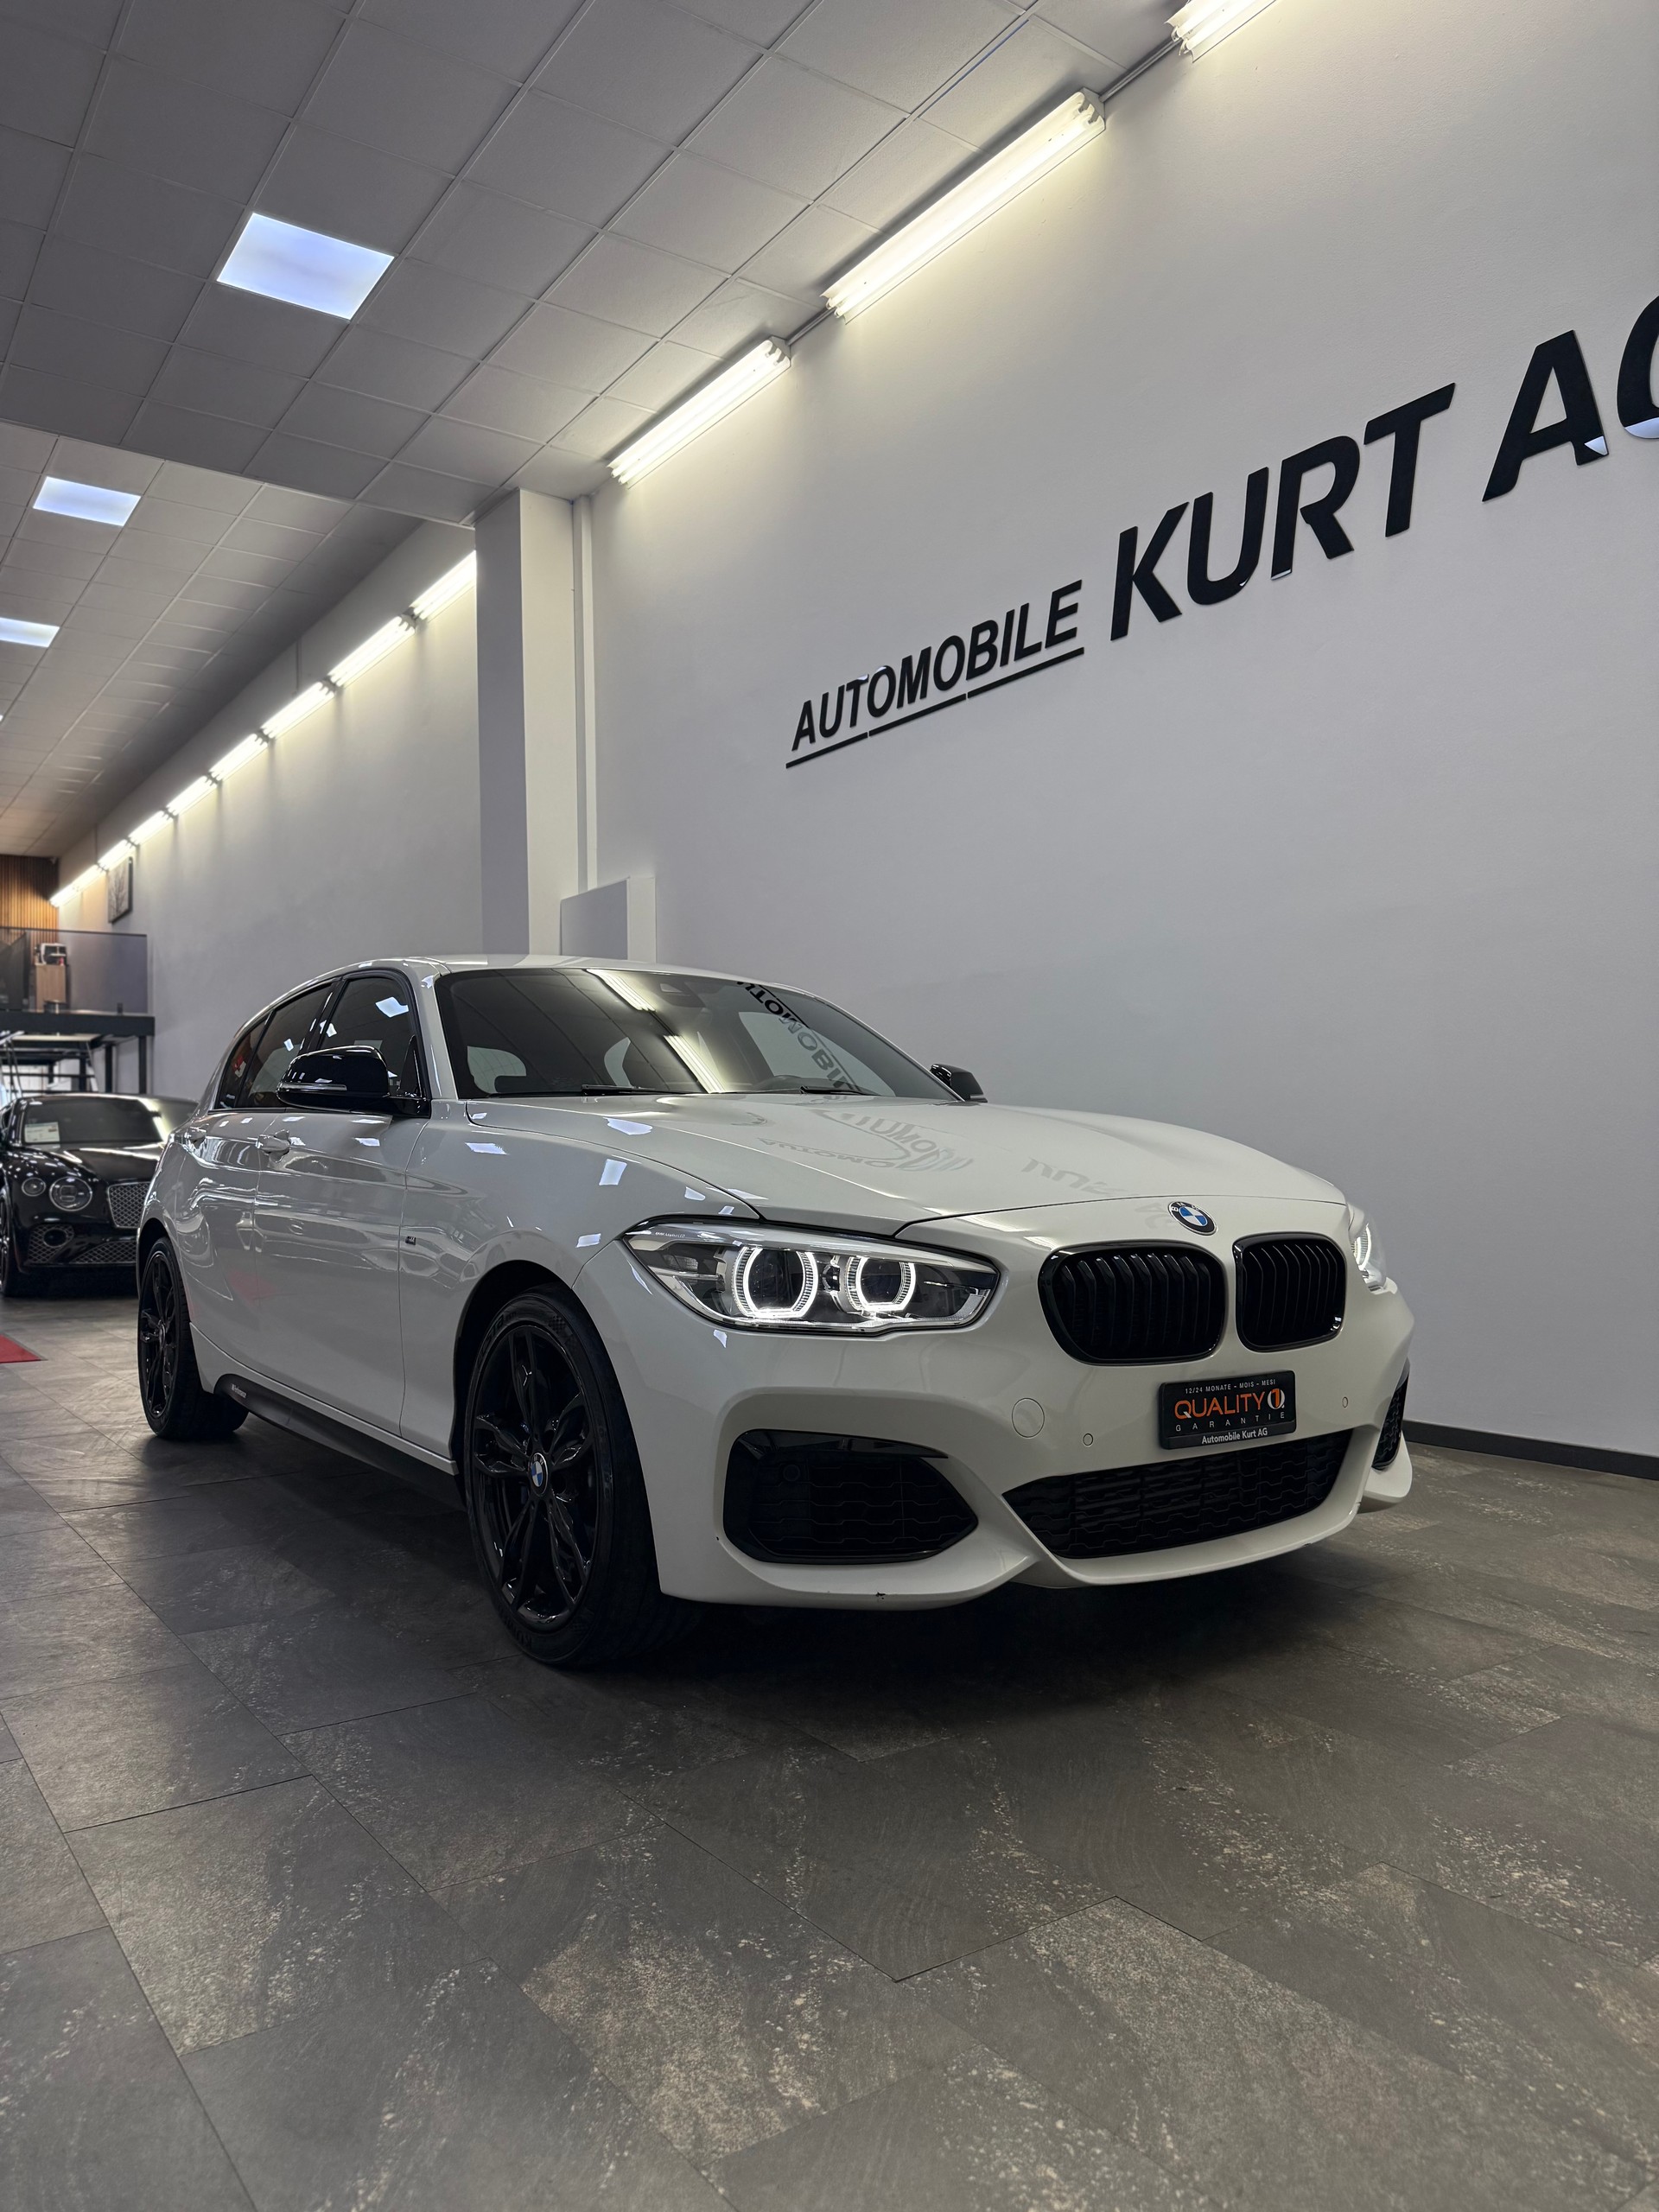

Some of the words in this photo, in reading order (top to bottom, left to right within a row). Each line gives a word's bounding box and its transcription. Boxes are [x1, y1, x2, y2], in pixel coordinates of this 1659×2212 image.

[791, 580, 1083, 750] AUTOMOBILE
[1110, 383, 1456, 641] KURT
[1174, 1391, 1265, 1420] QUALITY
[1175, 1411, 1285, 1432] GARANTIE
[1202, 1431, 1240, 1445] Automobile
[1242, 1430, 1256, 1440] Kurt
[1258, 1427, 1268, 1437] AG
